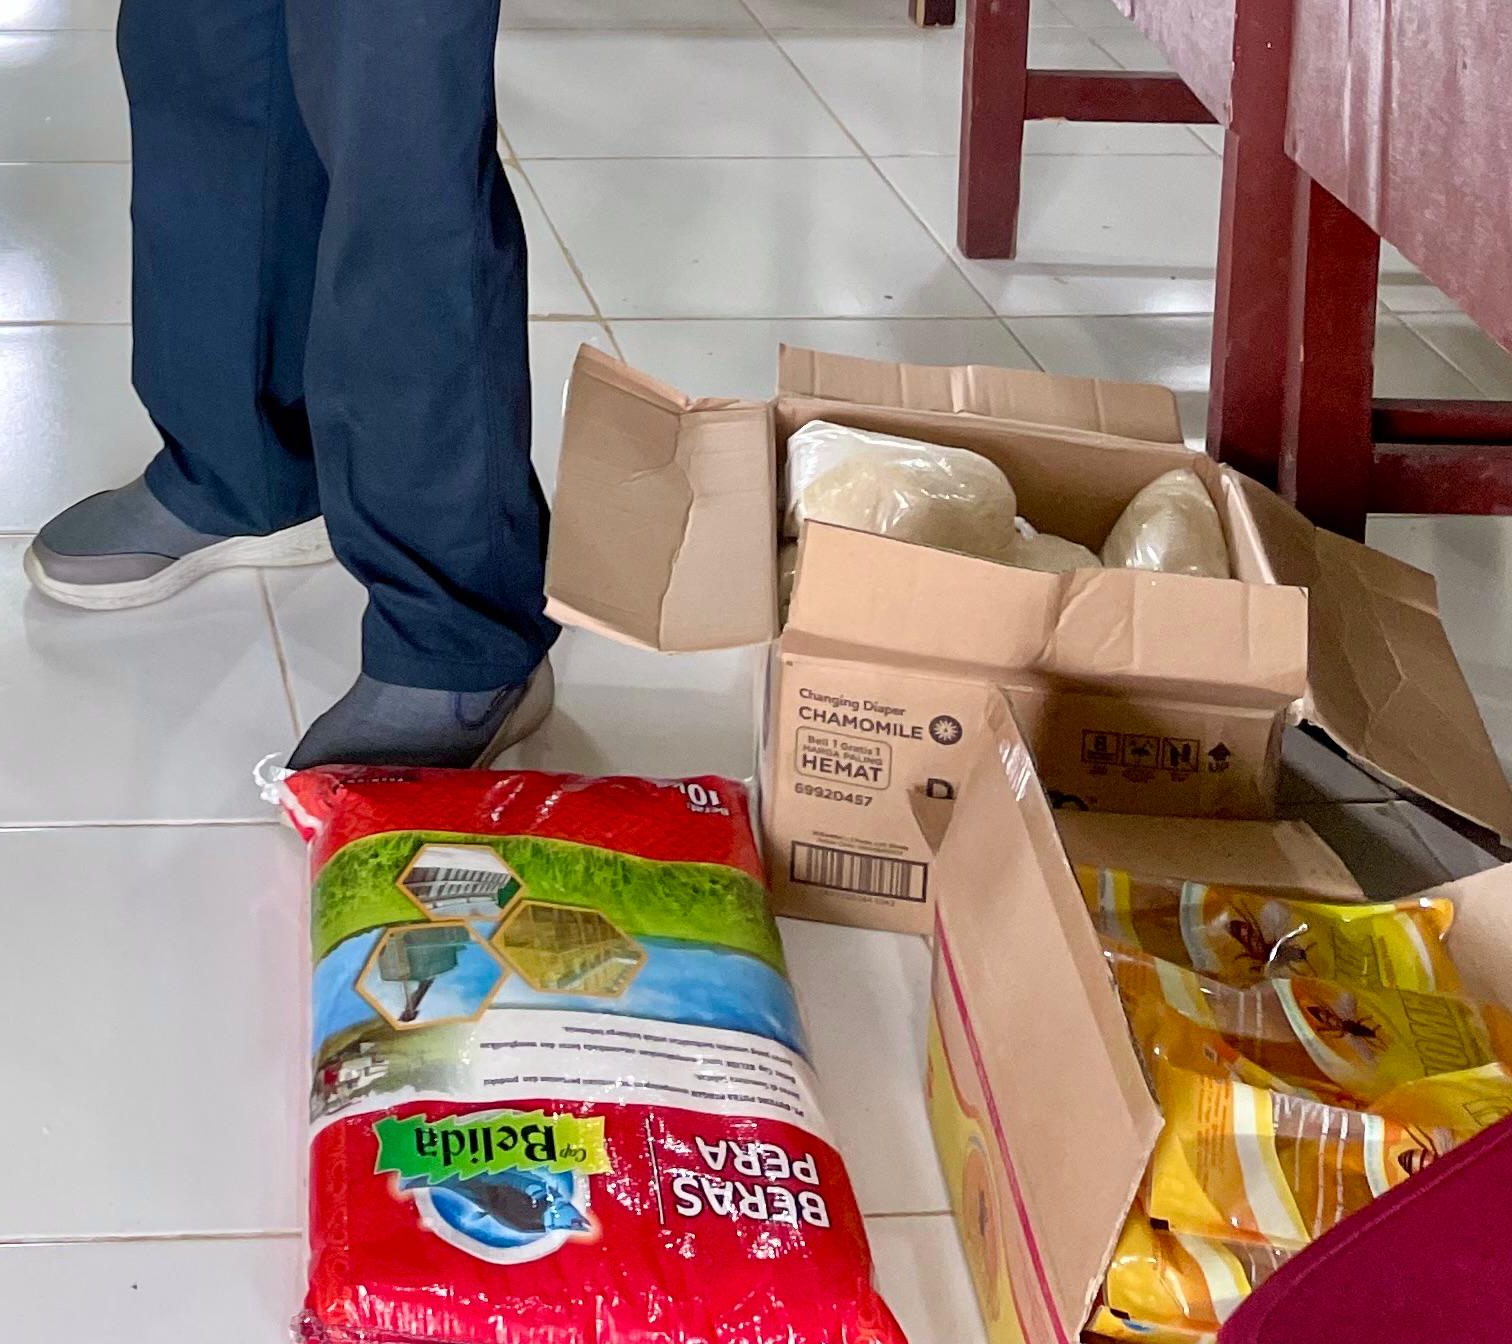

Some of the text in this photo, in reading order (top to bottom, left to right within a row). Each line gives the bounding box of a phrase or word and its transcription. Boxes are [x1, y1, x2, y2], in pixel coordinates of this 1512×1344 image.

[799, 687, 906, 717] Changing Diaper
[798, 706, 923, 740] CHAMOMILE
[802, 754, 883, 782] HEMAT
[687, 783, 720, 807] 10
[794, 783, 872, 807] 69920457
[414, 1122, 556, 1163] Belida
[696, 1137, 818, 1186] PERA
[675, 1174, 831, 1229] BERAS
